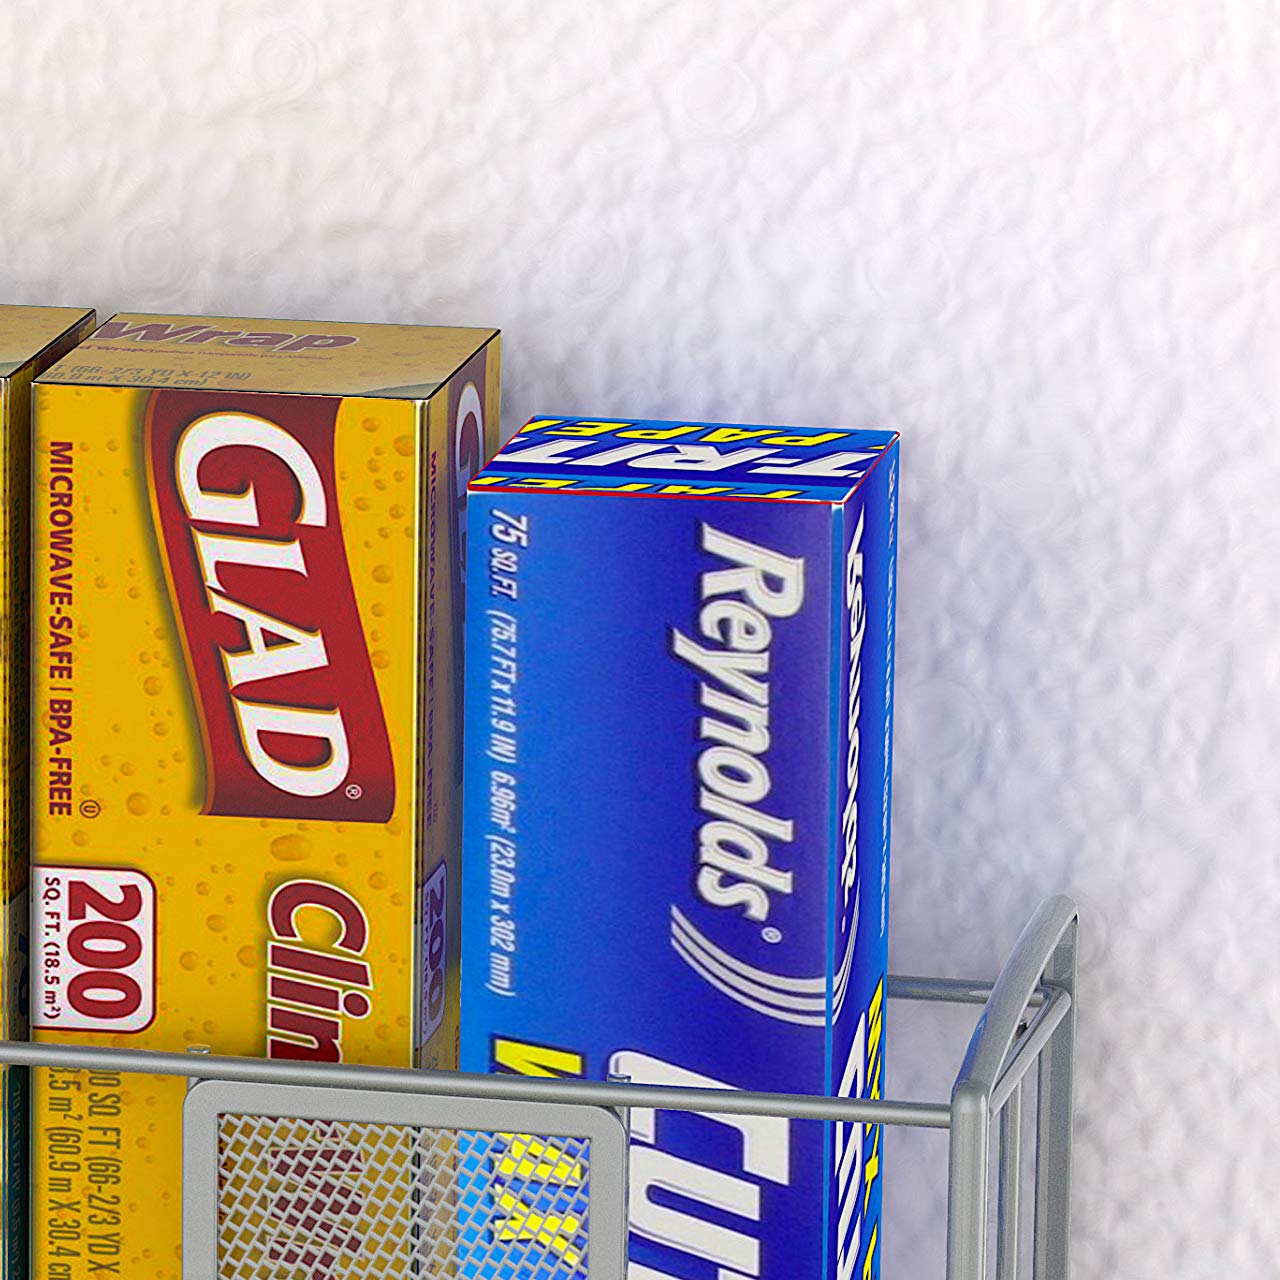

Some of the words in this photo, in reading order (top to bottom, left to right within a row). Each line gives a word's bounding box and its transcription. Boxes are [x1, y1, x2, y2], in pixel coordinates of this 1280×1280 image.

[92, 321, 359, 352] Wrap
[491, 508, 528, 547] 75
[49, 441, 73, 679] MICROWAVE-SAFE
[490, 547, 518, 573] SQ.
[175, 411, 350, 797] GLAD
[491, 574, 518, 599] FT.
[485, 609, 517, 658] (75.7
[491, 655, 517, 684] FT
[490, 696, 517, 733] 11.9
[672, 522, 805, 922] Reynolds
[49, 699, 73, 816] BPA-FREE
[485, 732, 517, 763] IN)
[484, 835, 517, 898] (23.0m
[43, 877, 61, 905] SQ.
[45, 911, 61, 936] FT.
[490, 914, 516, 952] 302
[43, 942, 61, 985] (18.5
[67, 880, 142, 1019] 200
[428, 876, 444, 1021] 200
[485, 952, 517, 997] mm)
[267, 879, 373, 1130] Clin
[88, 1093, 122, 1117] SQ
[44, 1126, 83, 1172] (60.9
[88, 1126, 121, 1150] FT
[48, 1177, 72, 1193] m
[84, 1156, 123, 1225] (66-2/3
[48, 1200, 82, 1213] X
[48, 1218, 82, 1257] 30.4
[88, 1232, 121, 1256] YD
[88, 1259, 121, 1274] X
